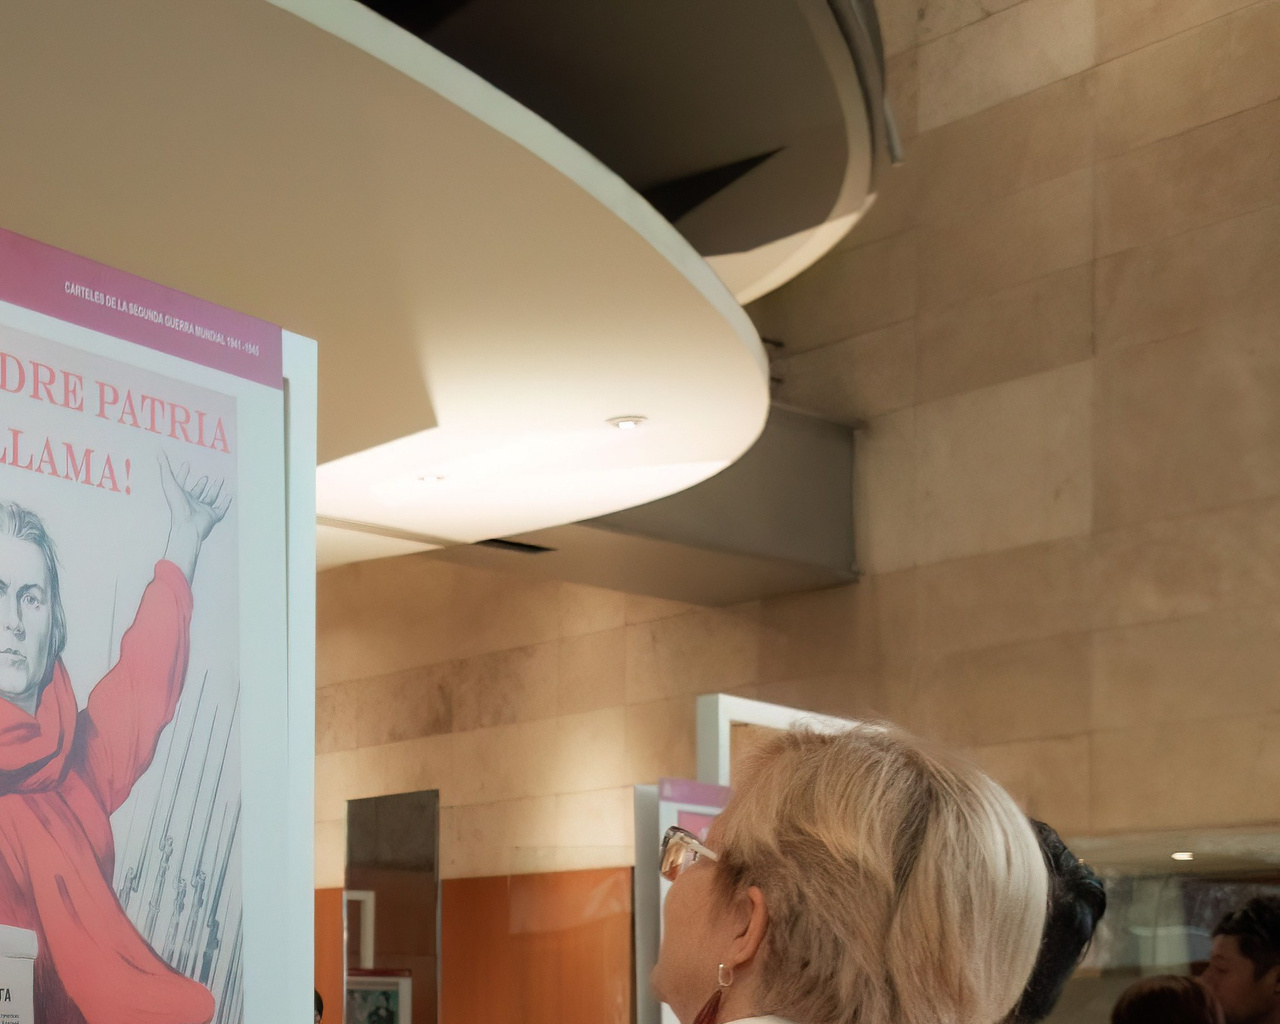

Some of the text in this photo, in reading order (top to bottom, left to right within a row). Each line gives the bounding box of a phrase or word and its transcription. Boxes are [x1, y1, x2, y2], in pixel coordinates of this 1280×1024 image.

[64, 281, 105, 306] CARTELES
[105, 295, 117, 309] DE
[117, 299, 128, 313] LA
[128, 303, 164, 325] SEGUNDA
[164, 315, 194, 335] GUERRA
[195, 325, 226, 346] MUNDIAL
[95, 380, 231, 454] PATRIA
